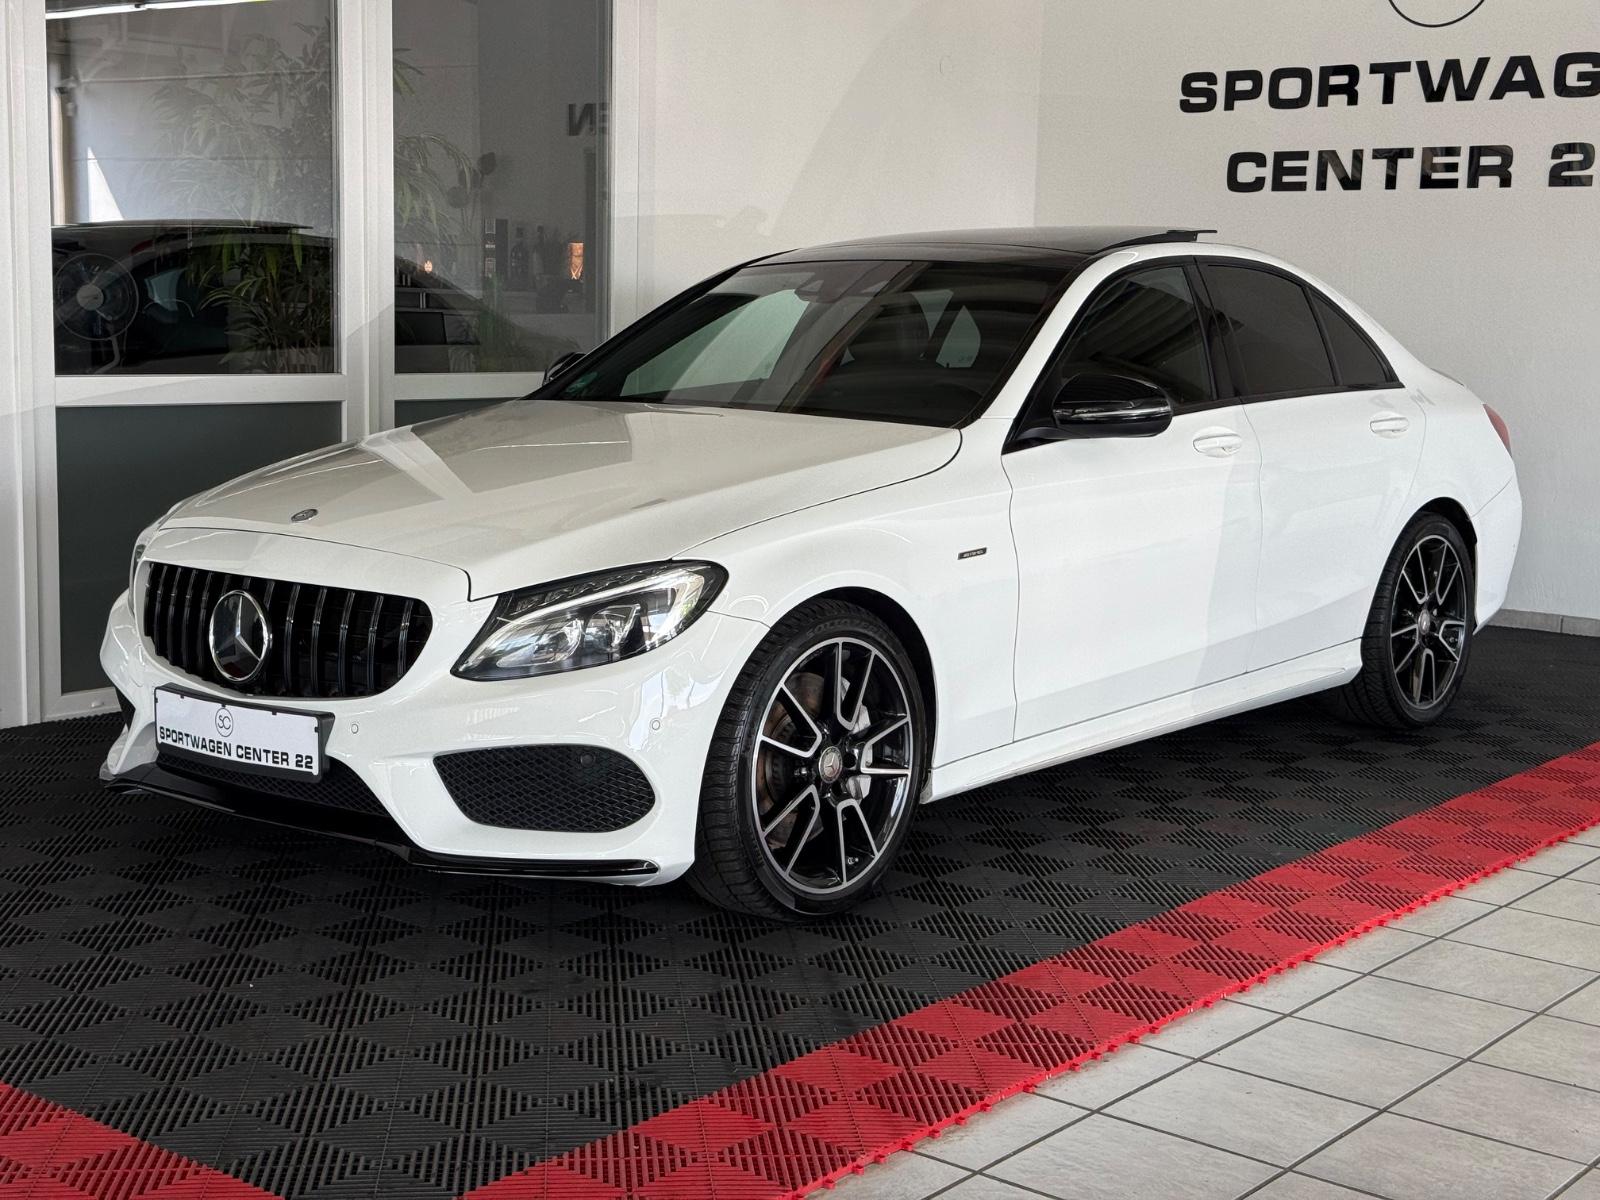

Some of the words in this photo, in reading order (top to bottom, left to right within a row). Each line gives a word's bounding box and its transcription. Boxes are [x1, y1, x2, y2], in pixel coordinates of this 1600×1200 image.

[1179, 52, 1600, 113] SPORTWAG
[1226, 144, 1514, 193] CENTER
[1548, 142, 1595, 187] 2
[217, 714, 231, 730] SC
[159, 726, 232, 757] SPORTWAGEN
[236, 744, 289, 767] CENTER
[295, 753, 313, 770] 22
